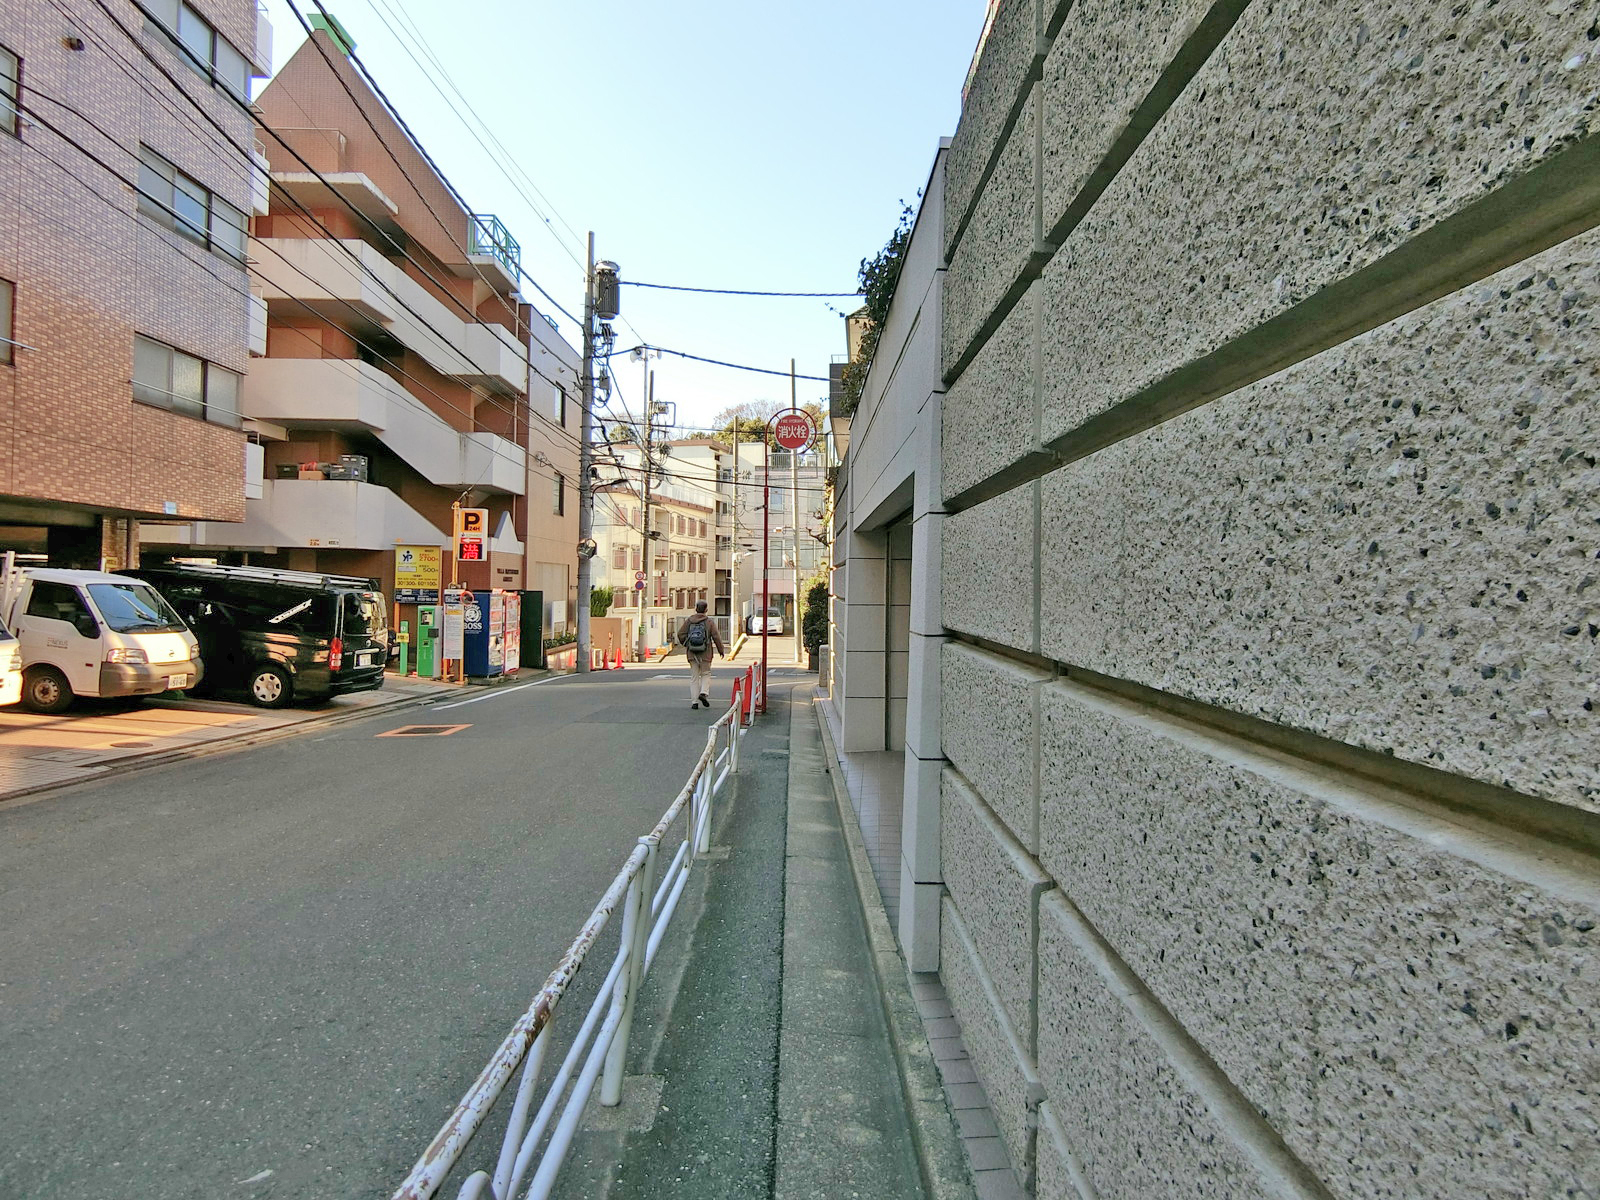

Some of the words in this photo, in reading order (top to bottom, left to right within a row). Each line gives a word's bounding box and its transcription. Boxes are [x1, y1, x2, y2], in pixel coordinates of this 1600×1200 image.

[778, 425, 807, 439] 消火栓
[464, 512, 480, 531] P
